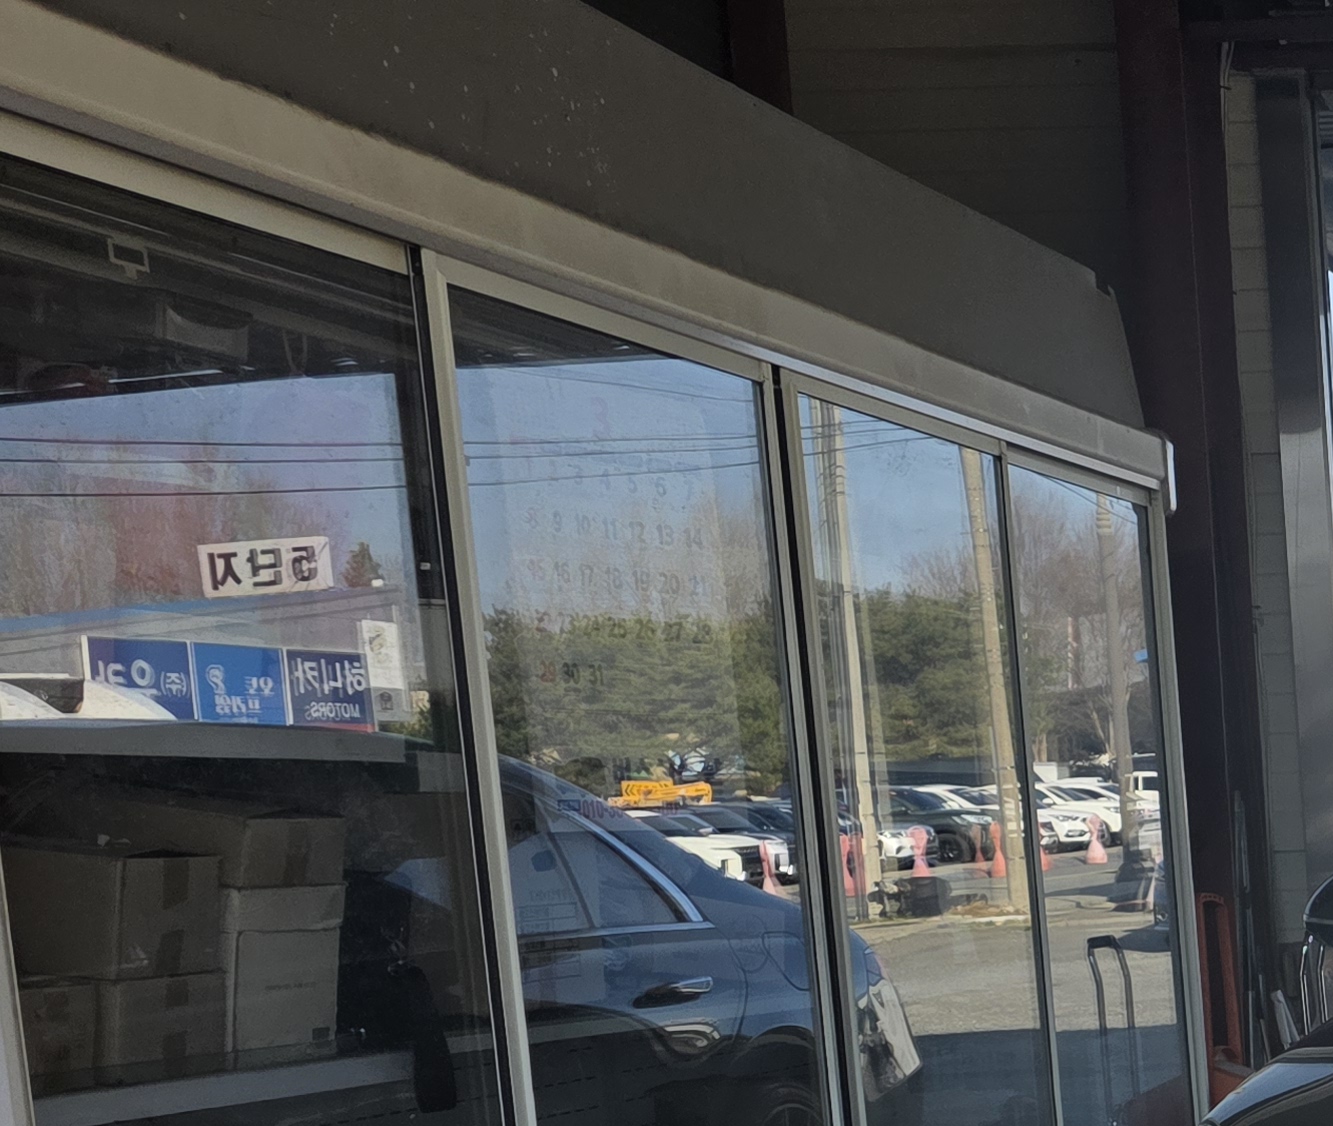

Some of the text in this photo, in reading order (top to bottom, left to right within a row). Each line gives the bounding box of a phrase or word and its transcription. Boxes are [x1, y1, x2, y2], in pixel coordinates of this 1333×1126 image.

[655, 523, 675, 546] 13
[683, 526, 704, 550] 14
[658, 572, 681, 595] 20
[562, 662, 581, 685] 30
[588, 663, 605, 687] 31
